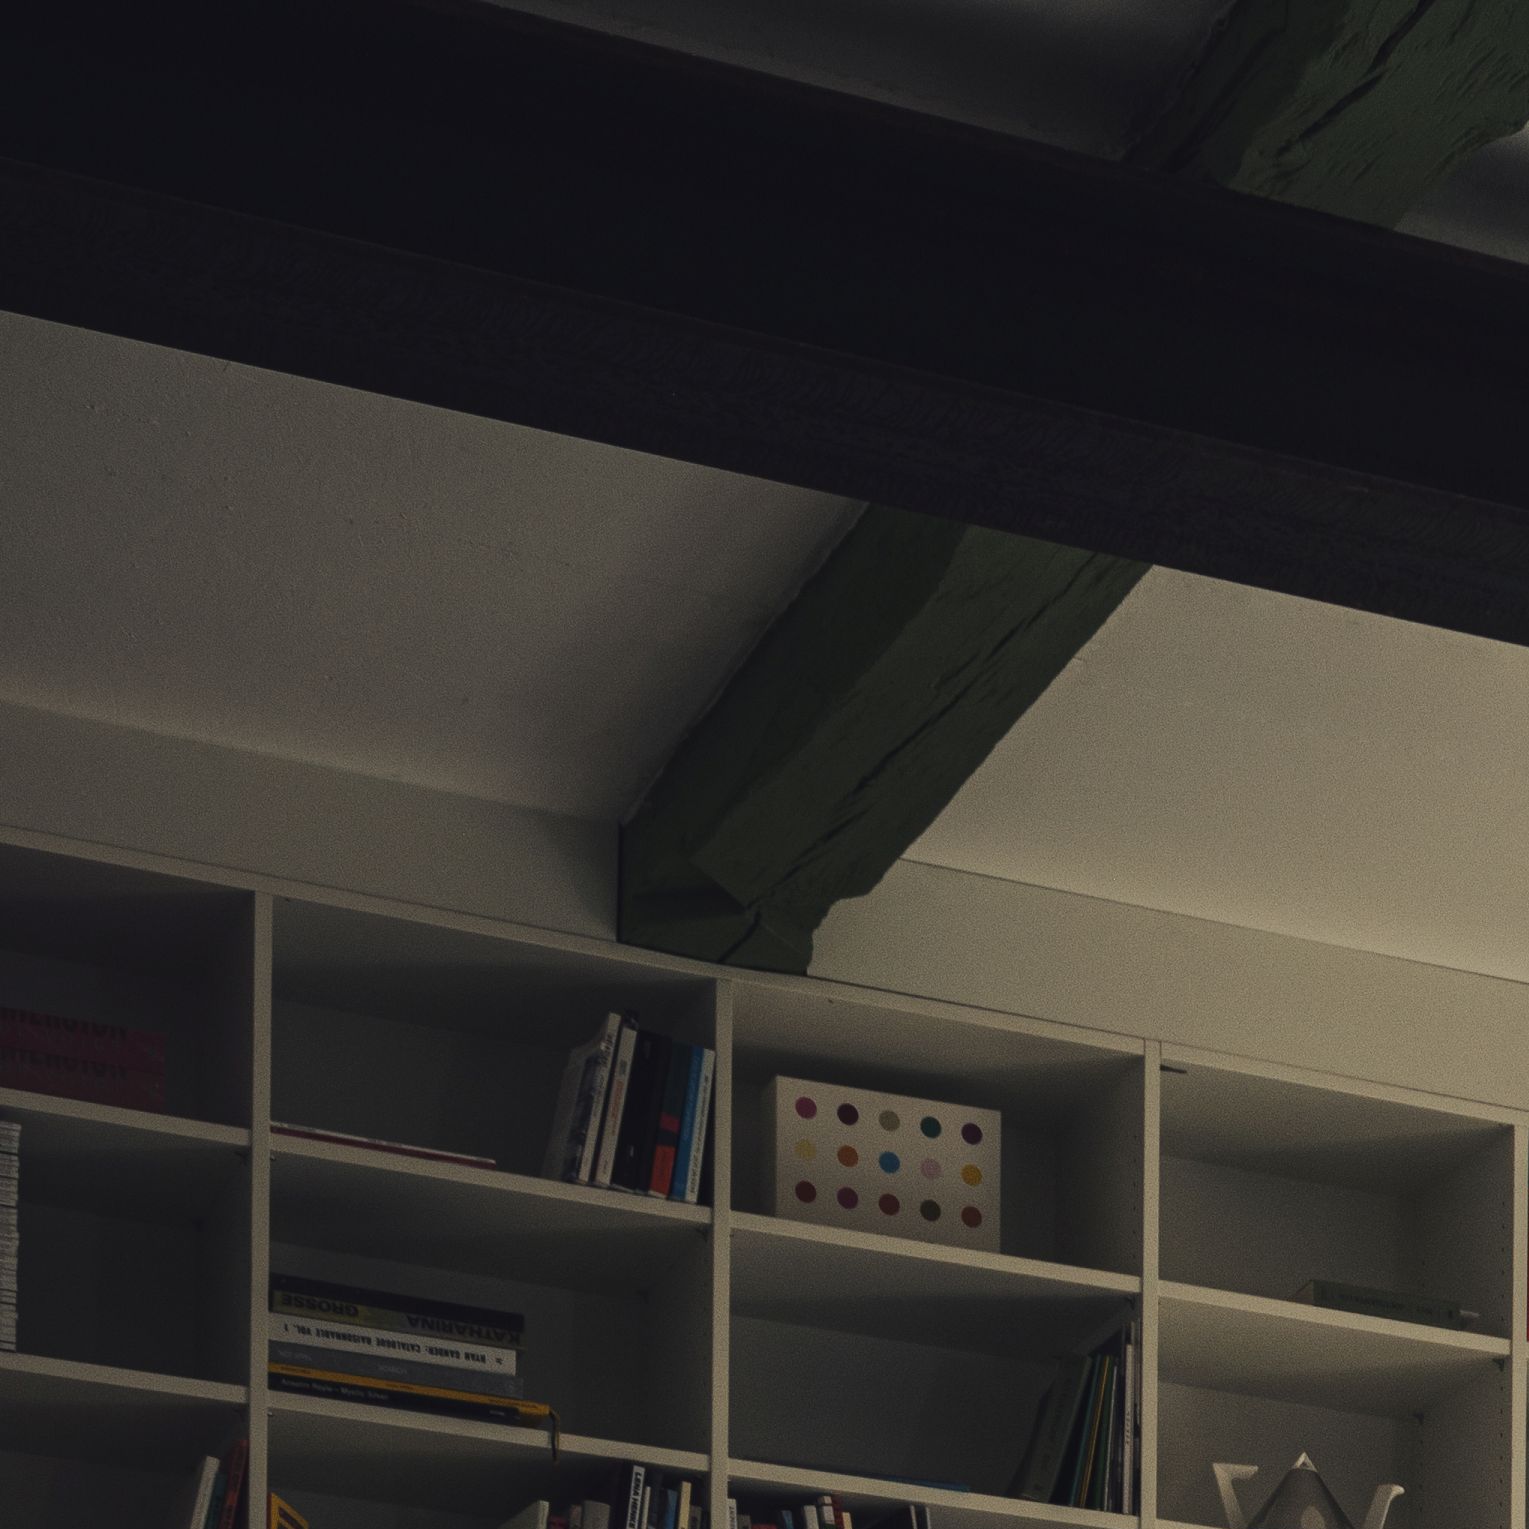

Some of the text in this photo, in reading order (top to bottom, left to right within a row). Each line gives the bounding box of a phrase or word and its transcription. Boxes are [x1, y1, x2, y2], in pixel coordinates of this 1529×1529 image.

[282, 1294, 520, 1345] KATHARINA GROSSE
[634, 1472, 642, 1496] LENA
[629, 1498, 638, 1529] HENKE
